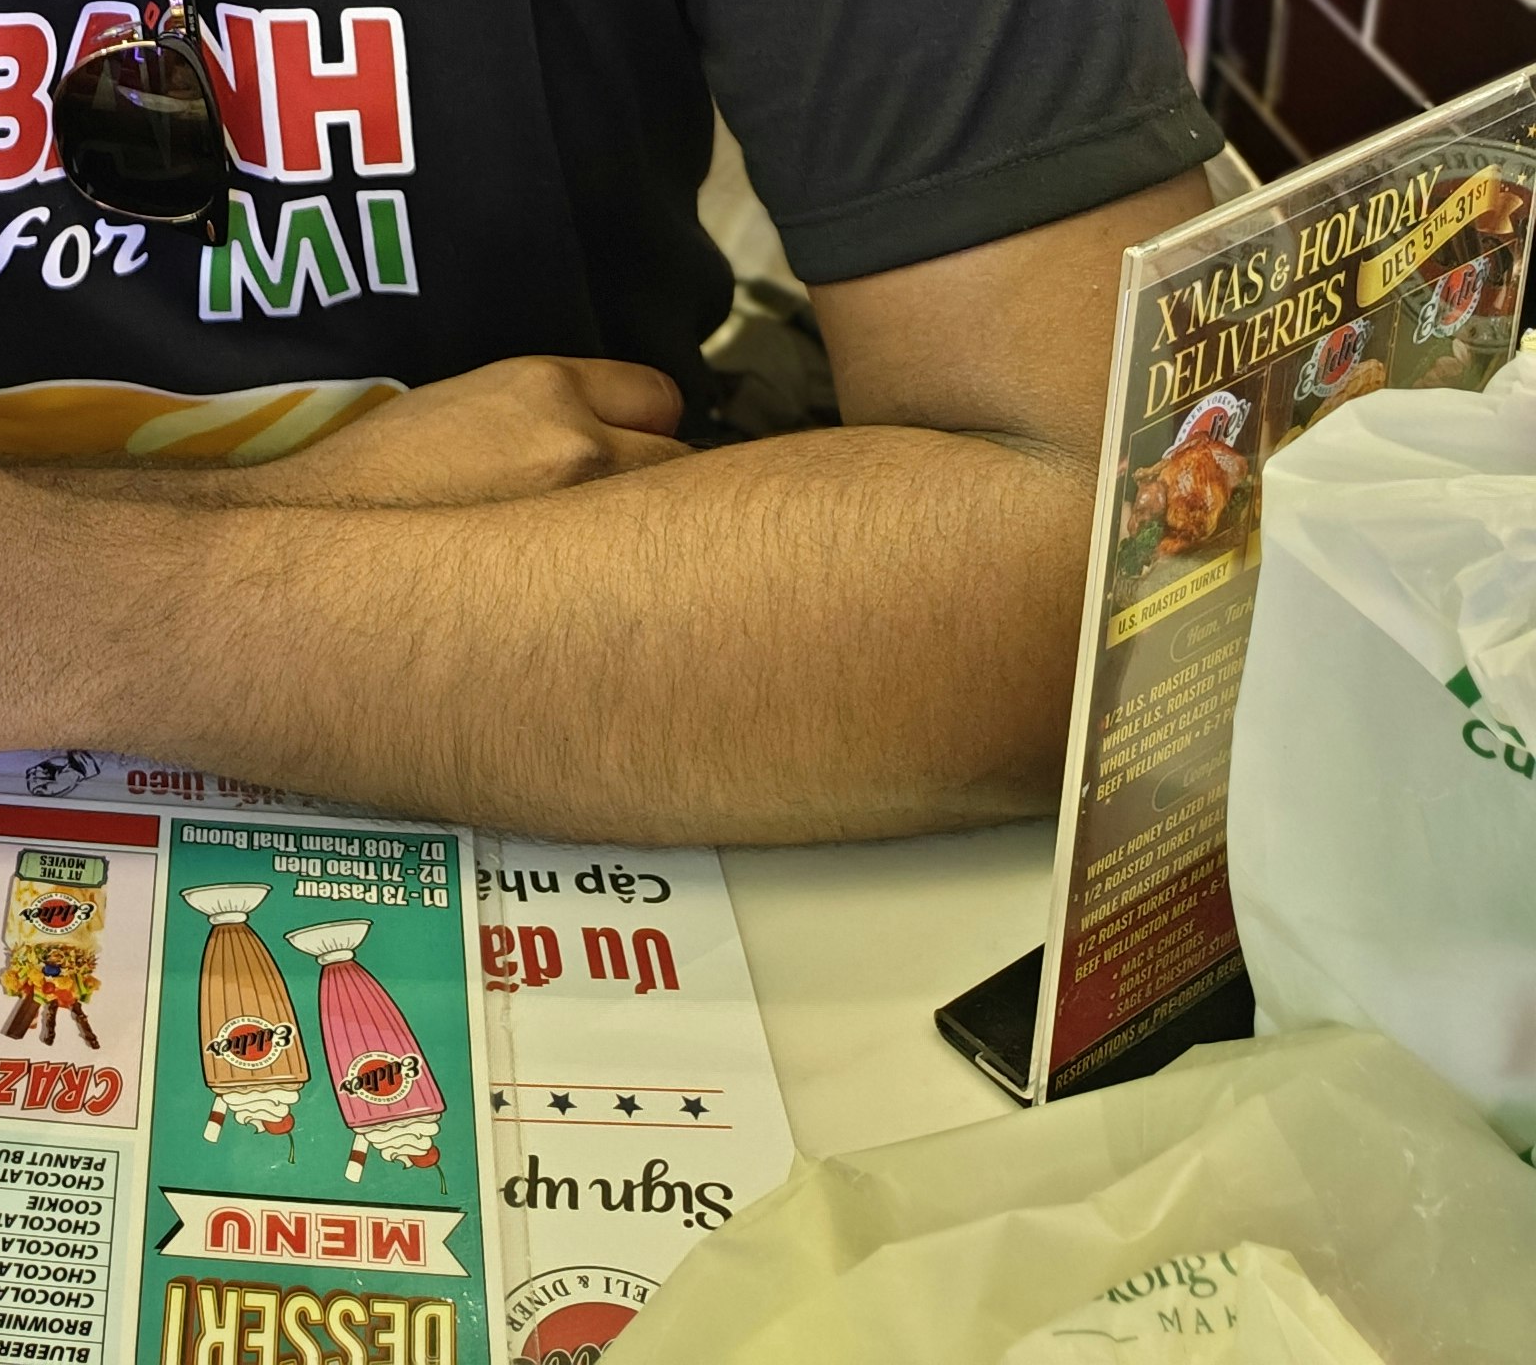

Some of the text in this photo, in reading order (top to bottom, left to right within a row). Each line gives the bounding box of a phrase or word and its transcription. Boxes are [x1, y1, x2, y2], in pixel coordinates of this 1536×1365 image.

[198, 189, 419, 322] MI
[1151, 165, 1444, 352] X'MAS & HOLIDAY
[1382, 235, 1417, 288] DEC
[1143, 270, 1346, 418] DELIVERIES
[1118, 560, 1229, 636] U.S. ROASTED TURKEY
[1104, 636, 1241, 730] 1/2 U.S. ROASTED TURKEY
[1096, 775, 1123, 802] BEEF
[1125, 730, 1193, 784] WELLINGTON
[181, 825, 249, 849] Buong
[251, 831, 297, 852] Thai
[299, 834, 360, 856] Pham
[362, 837, 405, 859] 408
[39, 854, 86, 870] MOVIES
[420, 840, 446, 860] D7
[39, 866, 83, 881] AT THE
[273, 854, 322, 876] Dien
[324, 857, 380, 881] Thao
[381, 862, 403, 881] 71
[420, 864, 447, 883] D2
[293, 879, 379, 905] Pasteur
[382, 885, 407, 906] 73
[574, 864, 671, 904] Cập
[423, 886, 450, 908] D1
[479, 924, 680, 995] Ưu đã
[206, 1025, 293, 1057] Eddie's
[339, 1055, 420, 1096] Eddie's
[26, 1151, 107, 1172] PEANUT
[498, 1154, 733, 1231] Sign up
[26, 1195, 103, 1216] COOKIE
[205, 1207, 427, 1267] MENU
[576, 1275, 590, 1289] &
[603, 1276, 650, 1305] ELI
